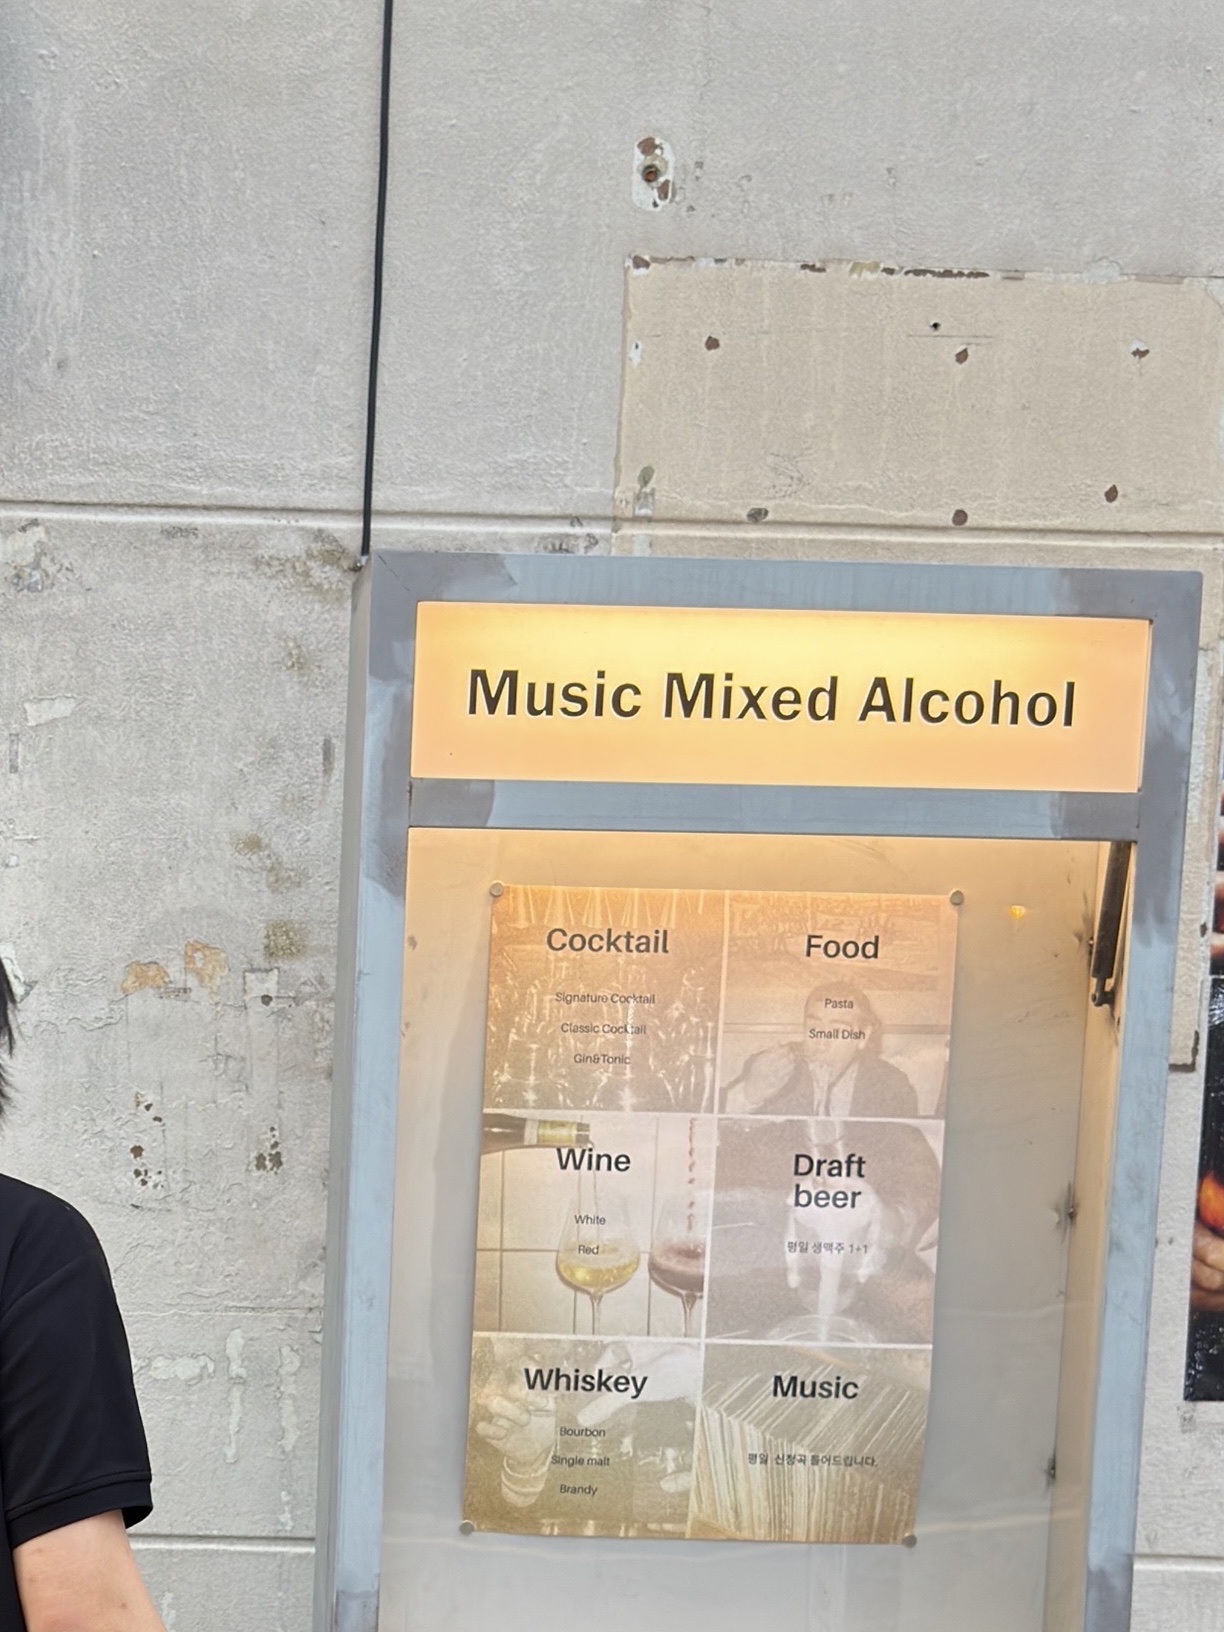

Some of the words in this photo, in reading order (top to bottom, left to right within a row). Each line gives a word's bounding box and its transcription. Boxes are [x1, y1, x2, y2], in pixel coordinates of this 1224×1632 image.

[468, 667, 642, 717] Music
[664, 671, 840, 722] Mixed
[856, 676, 1076, 728] Alcohol
[546, 927, 670, 955] Cocktail
[805, 934, 880, 960] Food
[555, 991, 609, 1005] Signature
[610, 992, 656, 1005] Cocktail
[824, 997, 854, 1009] Pasta
[560, 1022, 600, 1034] Classic
[808, 1027, 839, 1039] Small
[841, 1028, 866, 1040] Dish
[573, 1053, 632, 1066] Gin&Tonic
[555, 1146, 632, 1172] Wine
[792, 1152, 867, 1179] Draft
[793, 1183, 863, 1209] beer
[574, 1214, 606, 1226] White
[577, 1244, 599, 1255] Red
[786, 1240, 809, 1254] 평일
[811, 1240, 846, 1255] 생맥주
[848, 1242, 869, 1254] 1+1
[523, 1367, 649, 1399] Whiskey
[771, 1374, 860, 1400] Music
[559, 1426, 607, 1438] Bourbon
[550, 1454, 586, 1468] Single
[586, 1455, 611, 1467] malt
[747, 1452, 770, 1466] 평일
[559, 1483, 599, 1497] Brandy
